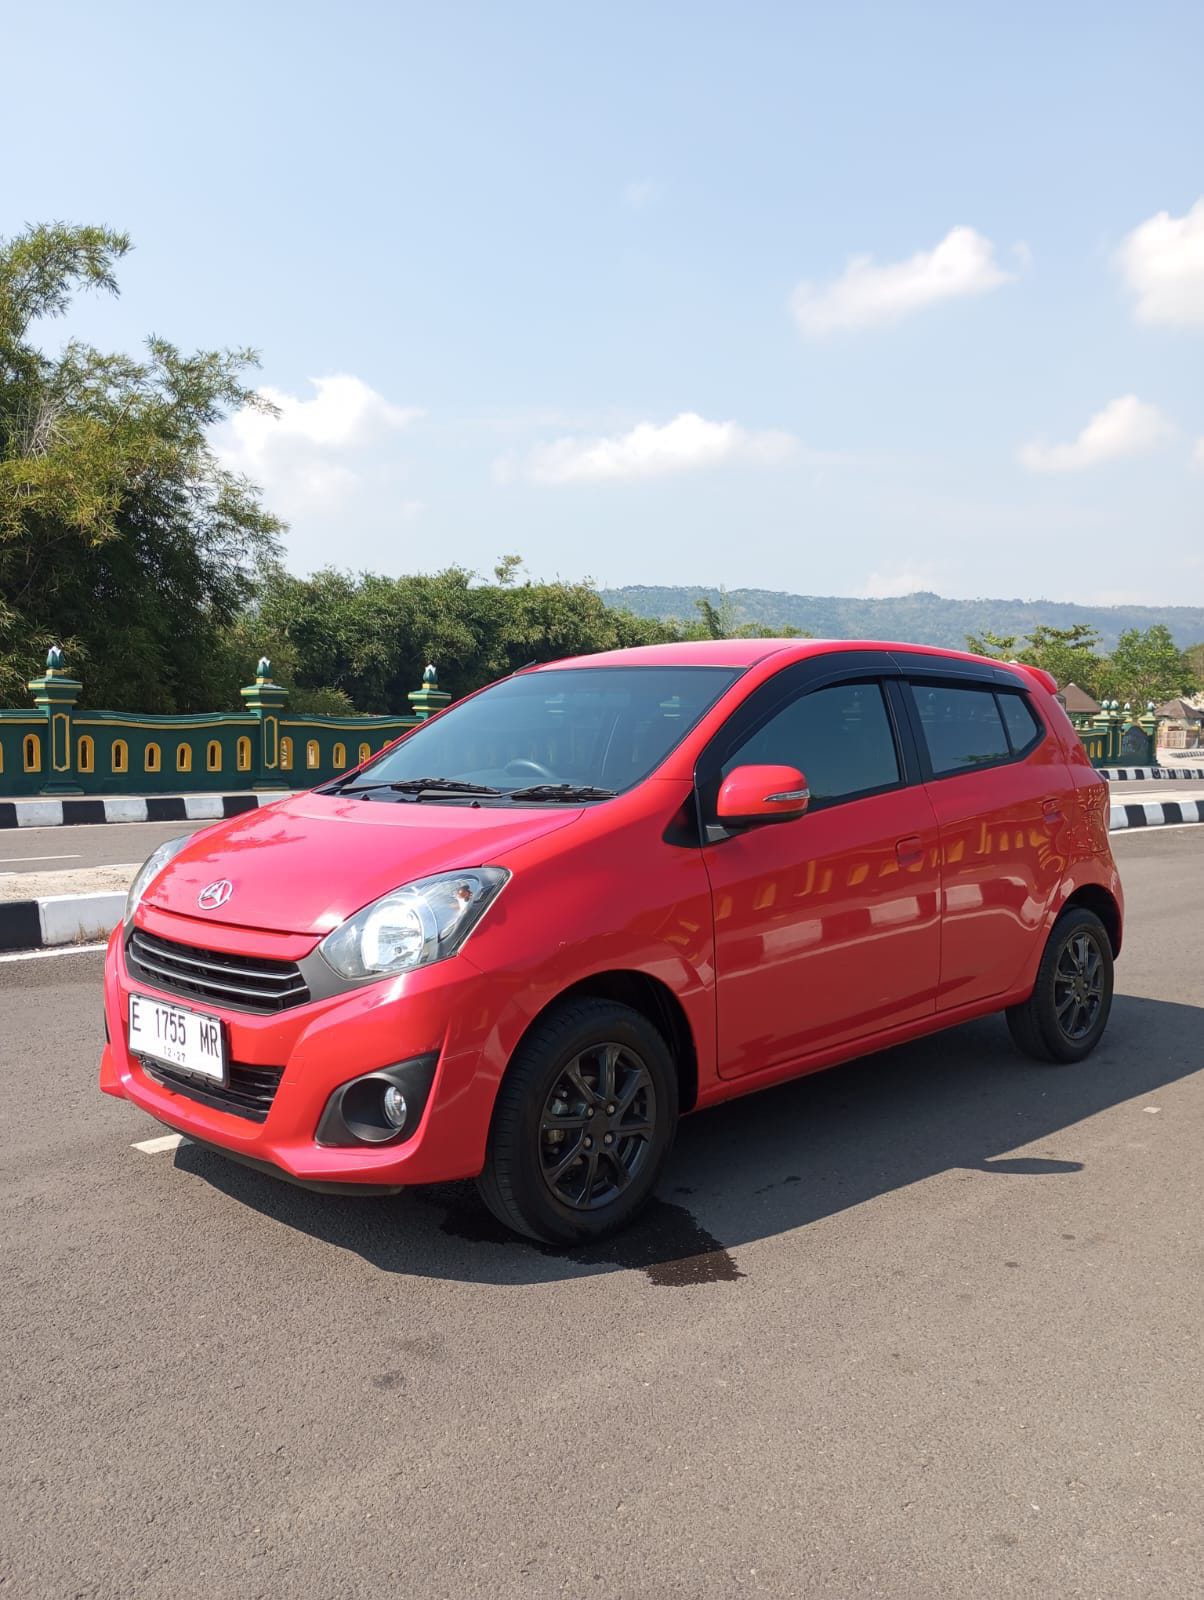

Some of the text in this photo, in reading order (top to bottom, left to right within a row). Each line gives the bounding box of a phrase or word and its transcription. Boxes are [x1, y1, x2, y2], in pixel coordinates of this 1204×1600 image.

[132, 1001, 219, 1058] E 1755 MR
